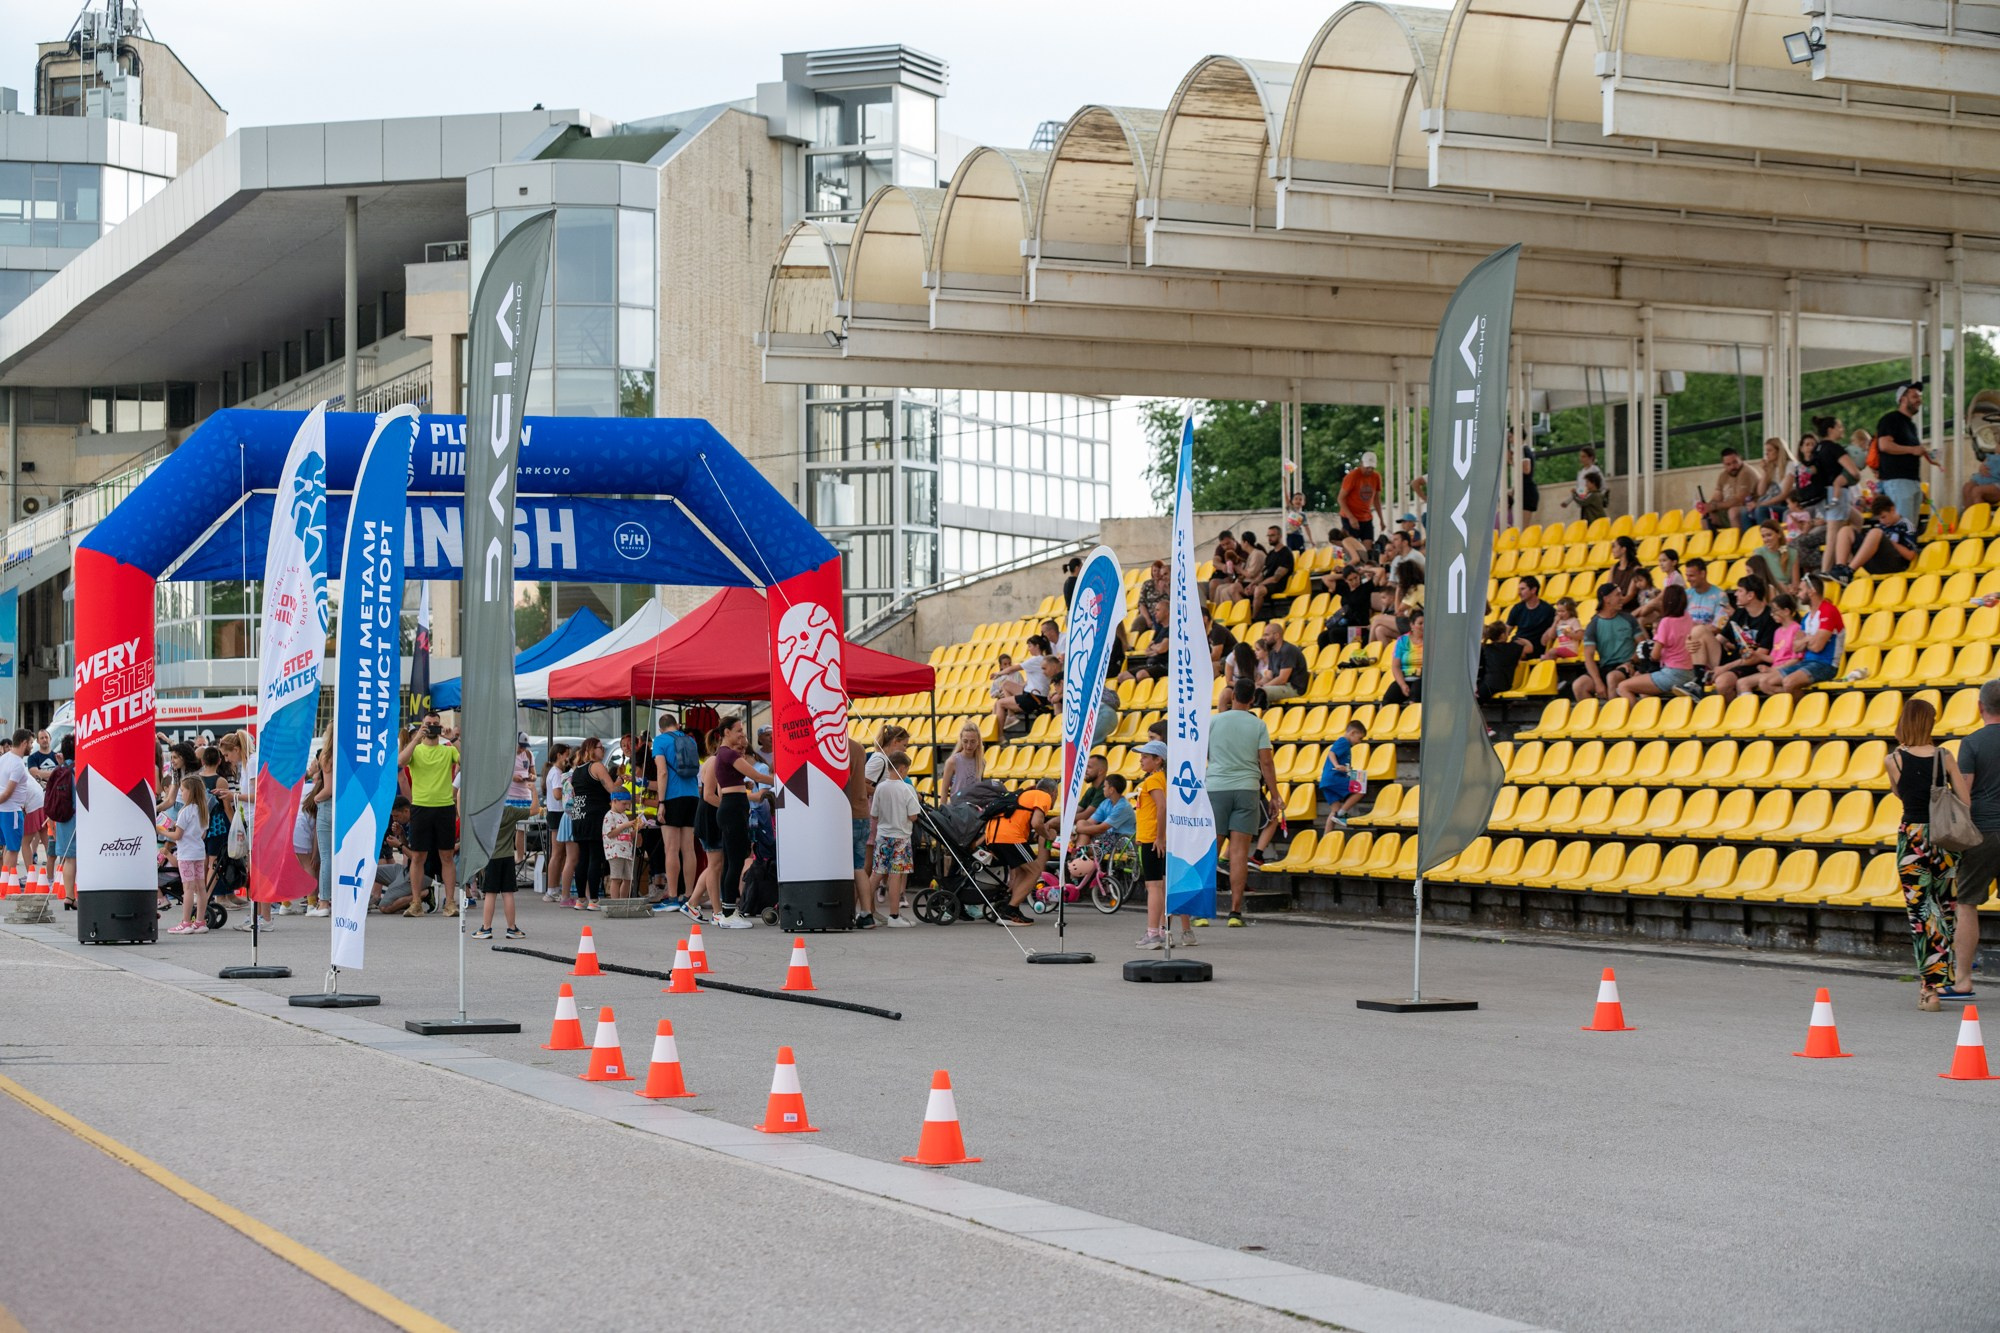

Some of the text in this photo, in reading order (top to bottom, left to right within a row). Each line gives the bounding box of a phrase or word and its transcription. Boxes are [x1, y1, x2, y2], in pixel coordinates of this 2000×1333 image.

[430, 451, 571, 476] HIL ARKOVO
[620, 533, 645, 546] P/H
[378, 520, 393, 629] СПОРТ
[356, 520, 377, 764] ЦЕННИ МЕТАЛИ
[75, 637, 141, 692] EVERY
[102, 657, 154, 702] STEP
[283, 649, 313, 678] STEP
[377, 636, 392, 720] ЧИСТ
[782, 717, 814, 732] PLOVDIV
[788, 727, 810, 741] HILLS
[1083, 708, 1095, 752] STEP
[1189, 708, 1200, 743] ЗА
